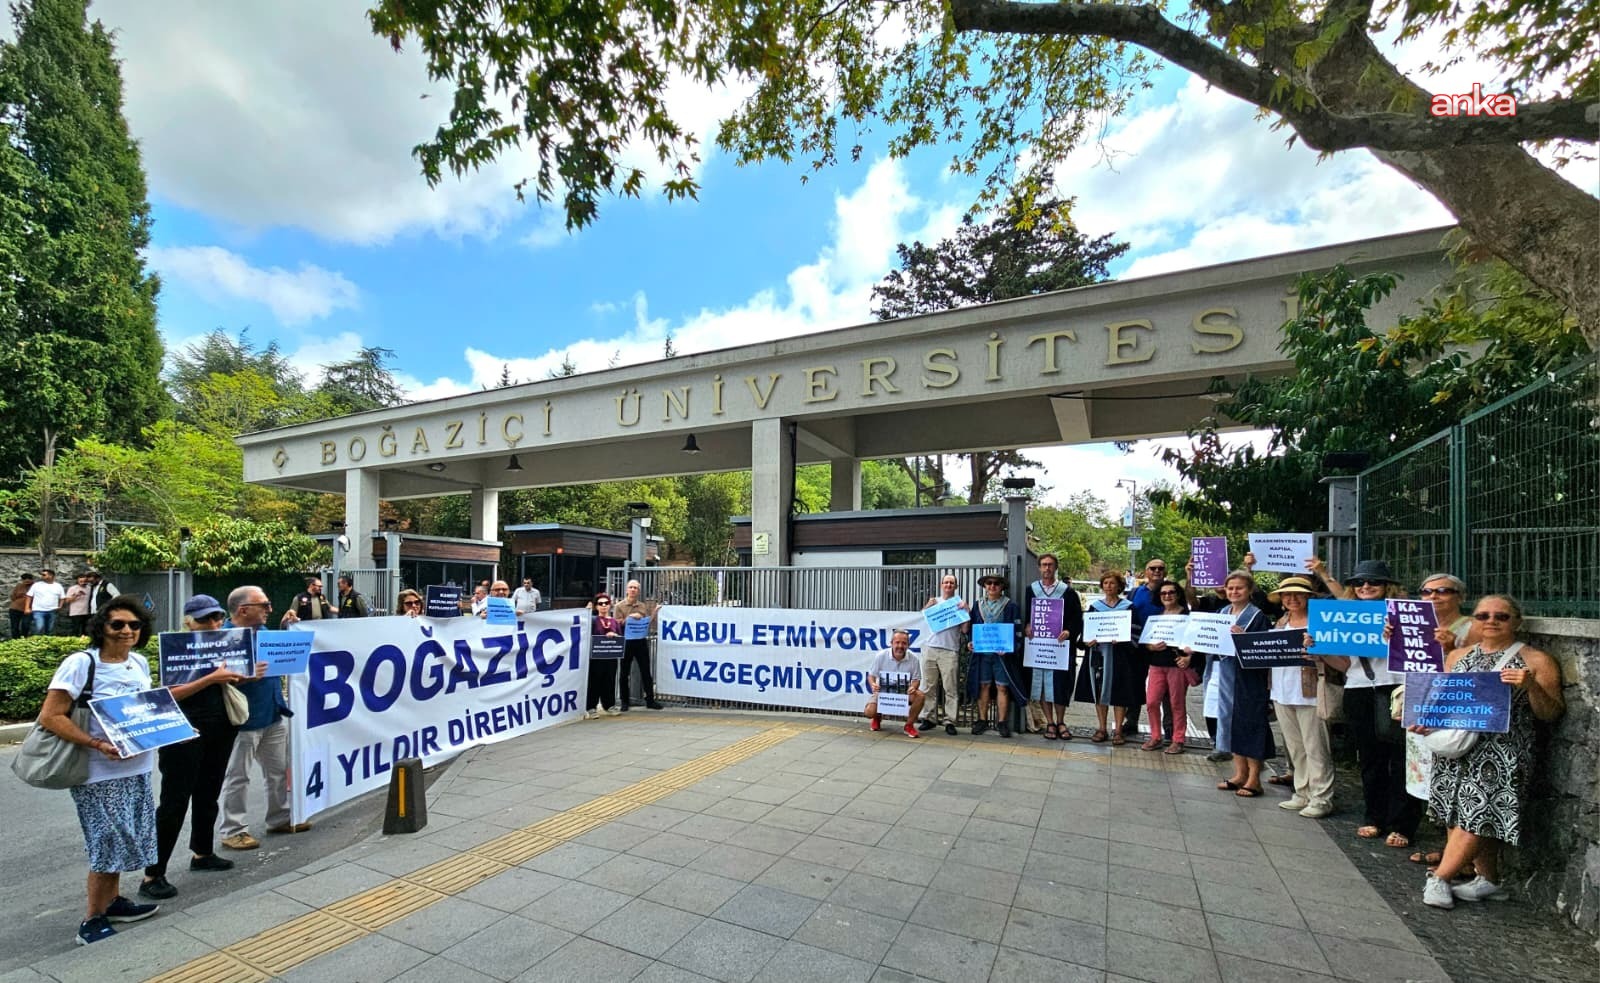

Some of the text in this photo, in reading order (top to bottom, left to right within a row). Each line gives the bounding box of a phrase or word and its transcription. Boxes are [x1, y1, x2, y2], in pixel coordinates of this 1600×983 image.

[320, 400, 552, 465] BOĞAZİÇİ
[1397, 602, 1423, 613] KA-
[1320, 611, 1388, 625] VAZGE
[1399, 614, 1430, 625] BUL
[661, 620, 743, 645] KABUL
[1315, 628, 1388, 645] MİYOR
[1401, 626, 1425, 637] ET-
[186, 639, 229, 650] KAMPÜS
[1404, 636, 1430, 648] Mİ-
[1404, 649, 1433, 661] YO-
[306, 615, 582, 730] BOĞAZİÇİ
[1403, 661, 1438, 673] RUZ
[671, 659, 873, 695] VAZGEÇMİYOR
[1413, 704, 1493, 715] DEMOKRATİK
[1416, 716, 1488, 729] ÜNİVERSİTE
[305, 689, 578, 799] 4 YILDIR DİRENİYOR
